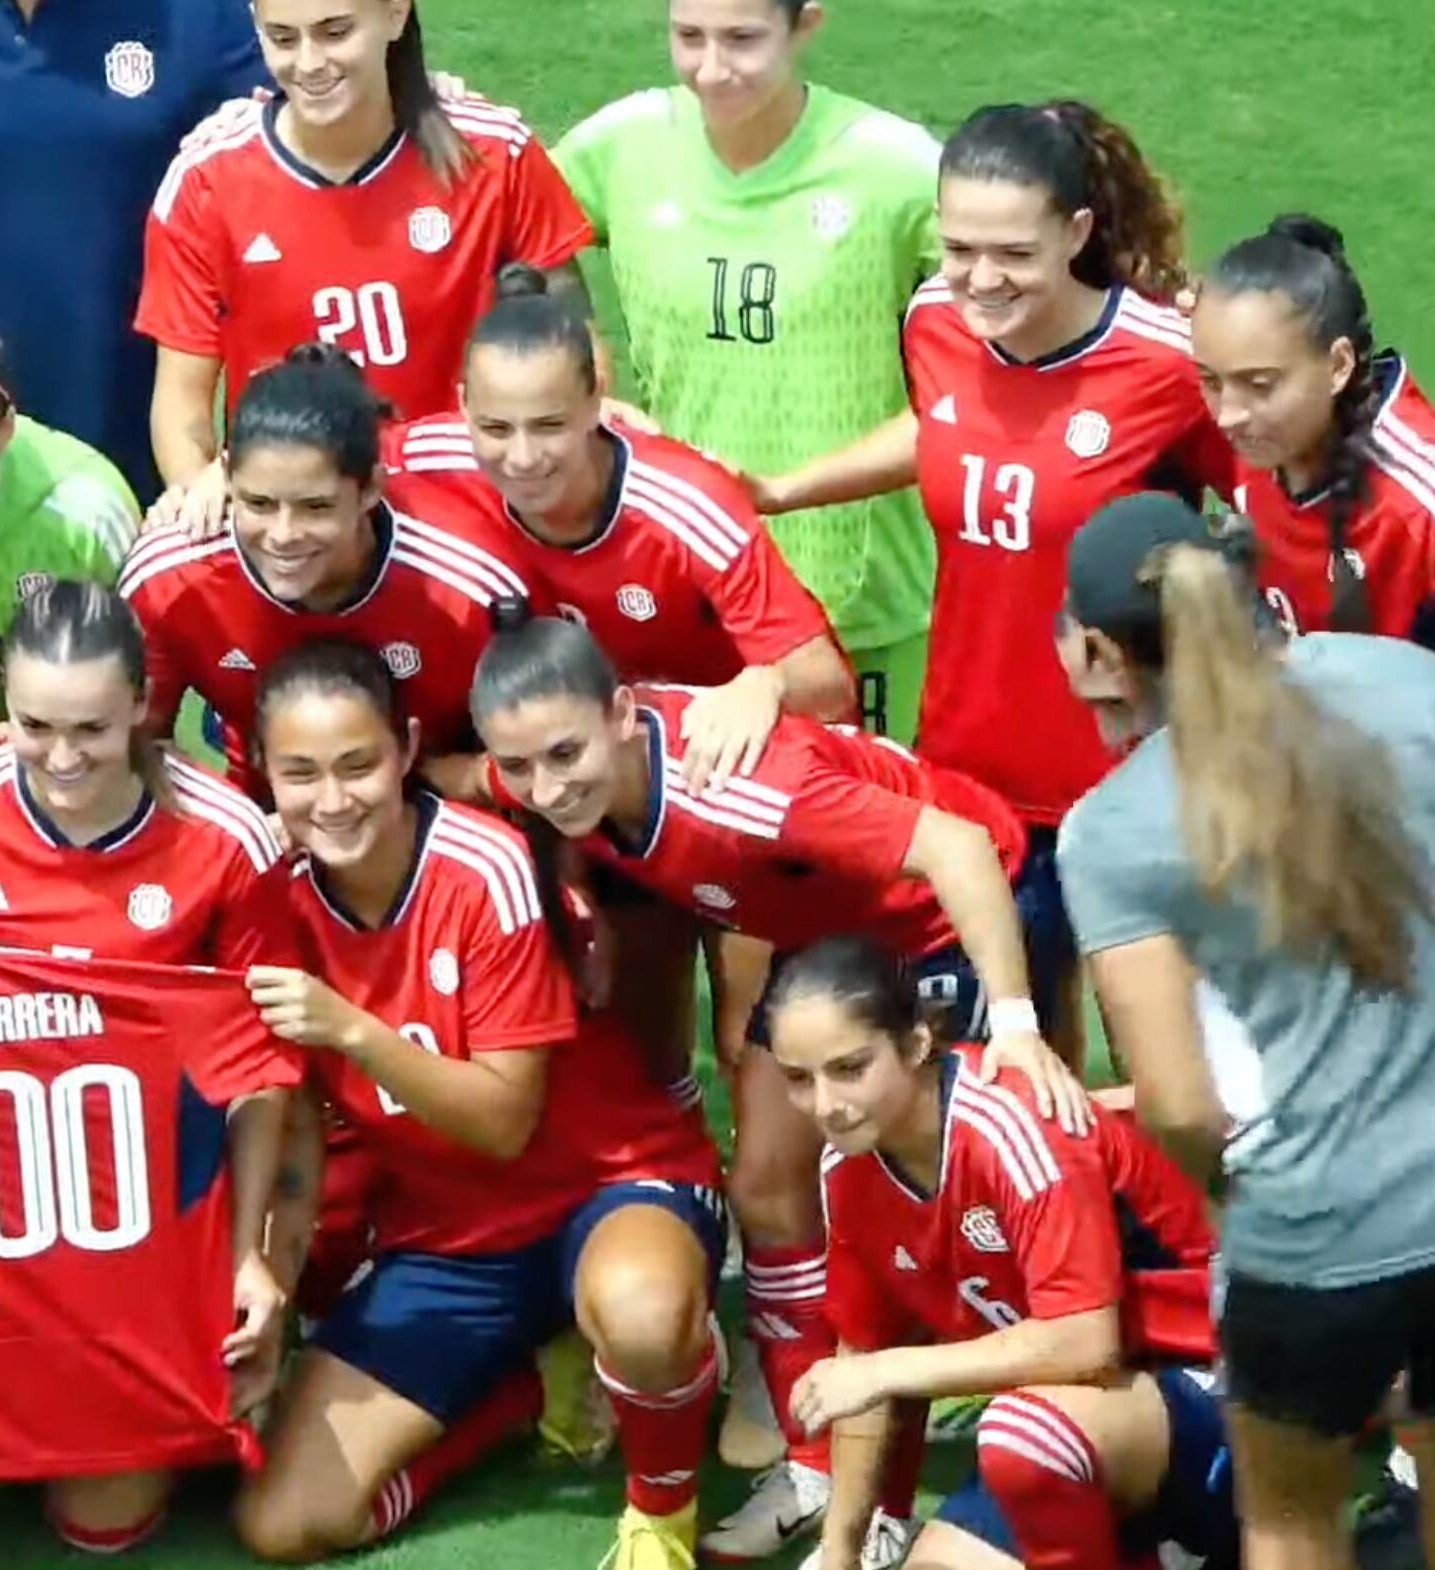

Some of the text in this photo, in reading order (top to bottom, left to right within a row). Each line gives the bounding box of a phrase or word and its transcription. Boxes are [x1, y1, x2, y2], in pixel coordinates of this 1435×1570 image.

[313, 281, 407, 368] 20
[707, 257, 776, 344] 18
[959, 454, 1034, 549] 13
